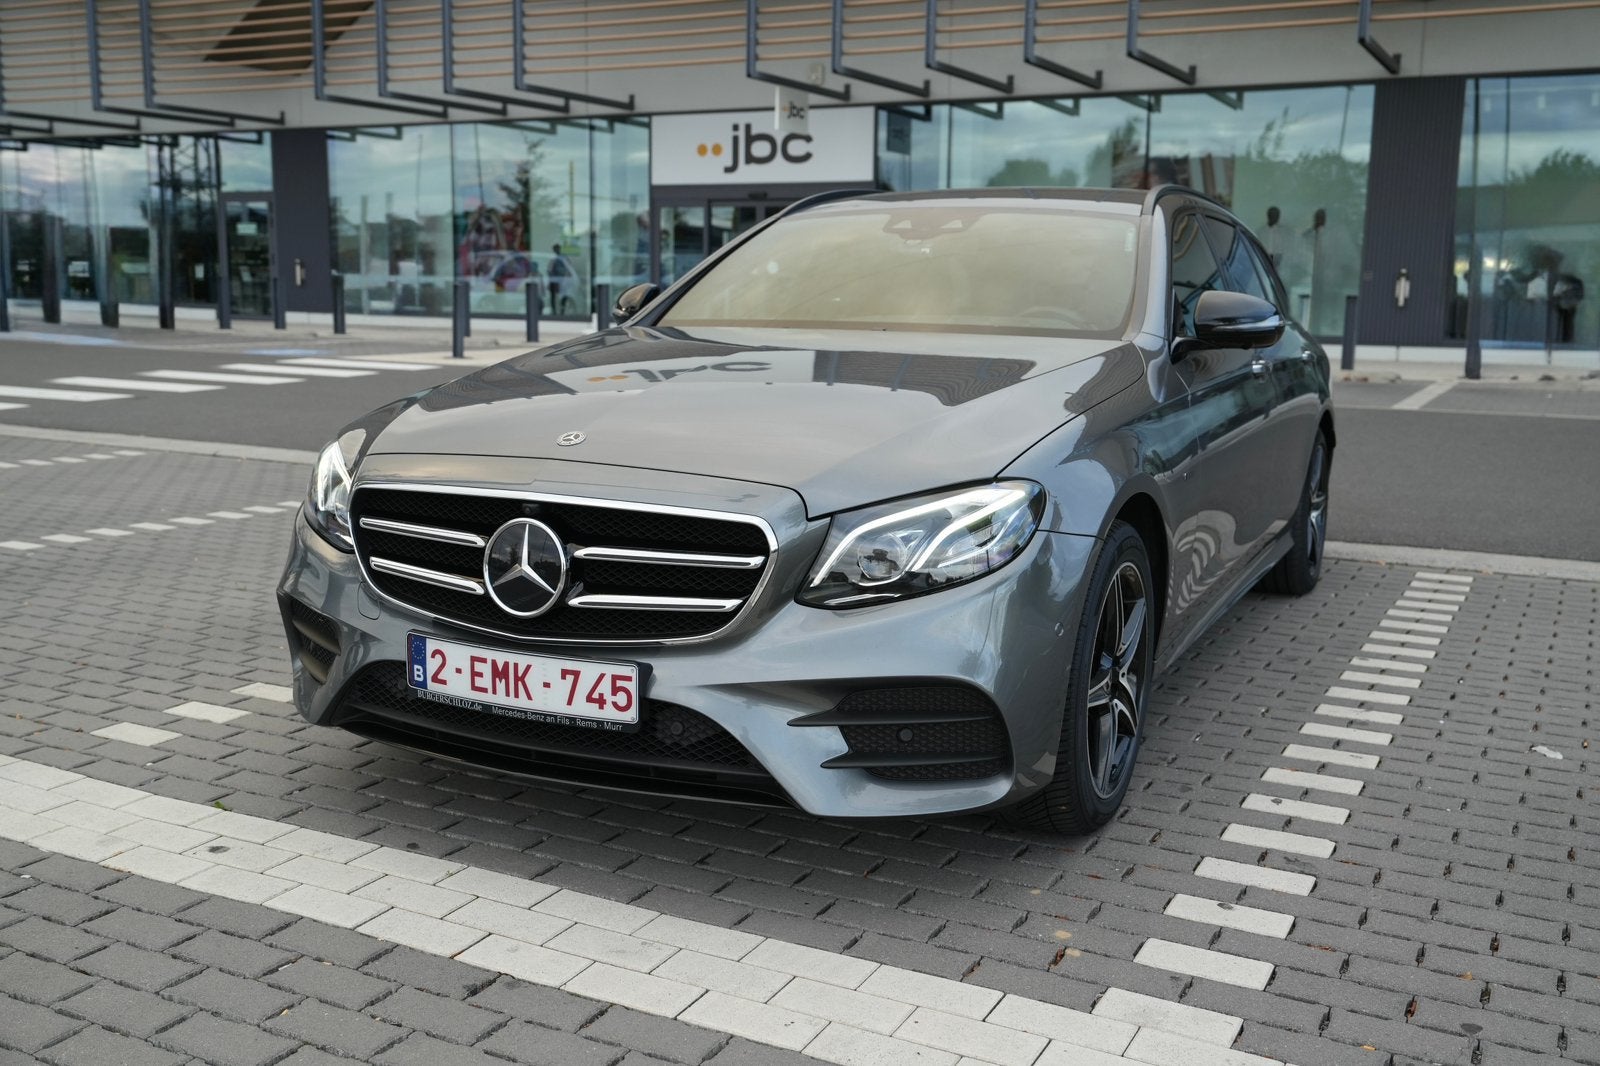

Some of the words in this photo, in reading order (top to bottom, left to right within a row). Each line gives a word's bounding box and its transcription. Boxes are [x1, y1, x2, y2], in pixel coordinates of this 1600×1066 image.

[787, 101, 805, 119] jbc
[724, 123, 813, 173] jbc
[413, 664, 424, 682] B
[431, 649, 633, 713] 2-EMK-745
[492, 706, 544, 722] Mercedes-Benz
[556, 715, 569, 725] Fils
[576, 718, 597, 729] Rems
[603, 722, 623, 731] Murr
